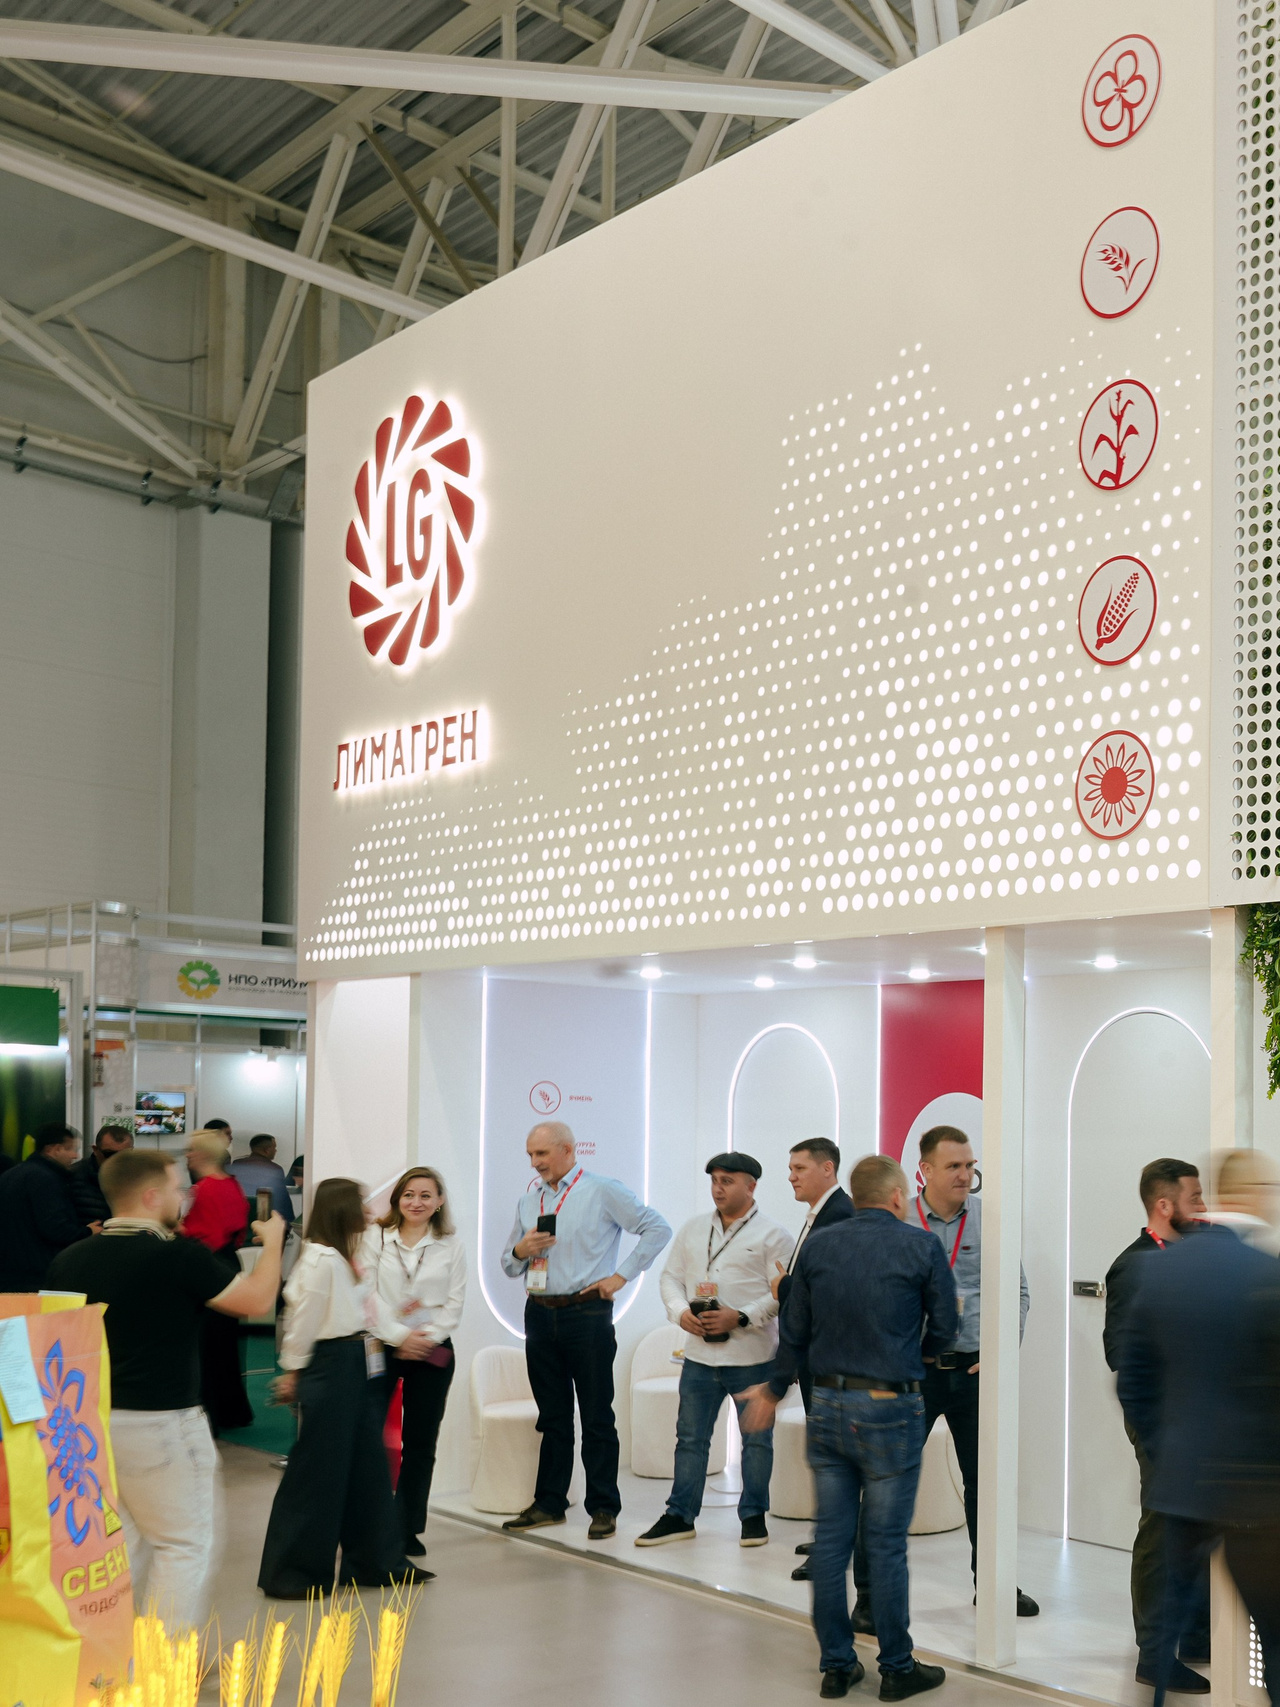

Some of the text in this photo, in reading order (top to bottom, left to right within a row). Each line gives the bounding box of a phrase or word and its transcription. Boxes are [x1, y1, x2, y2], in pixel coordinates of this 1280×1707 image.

[386, 467, 434, 588] LG
[333, 709, 479, 791] ЛИМАГРЕН
[228, 973, 258, 986] НПО
